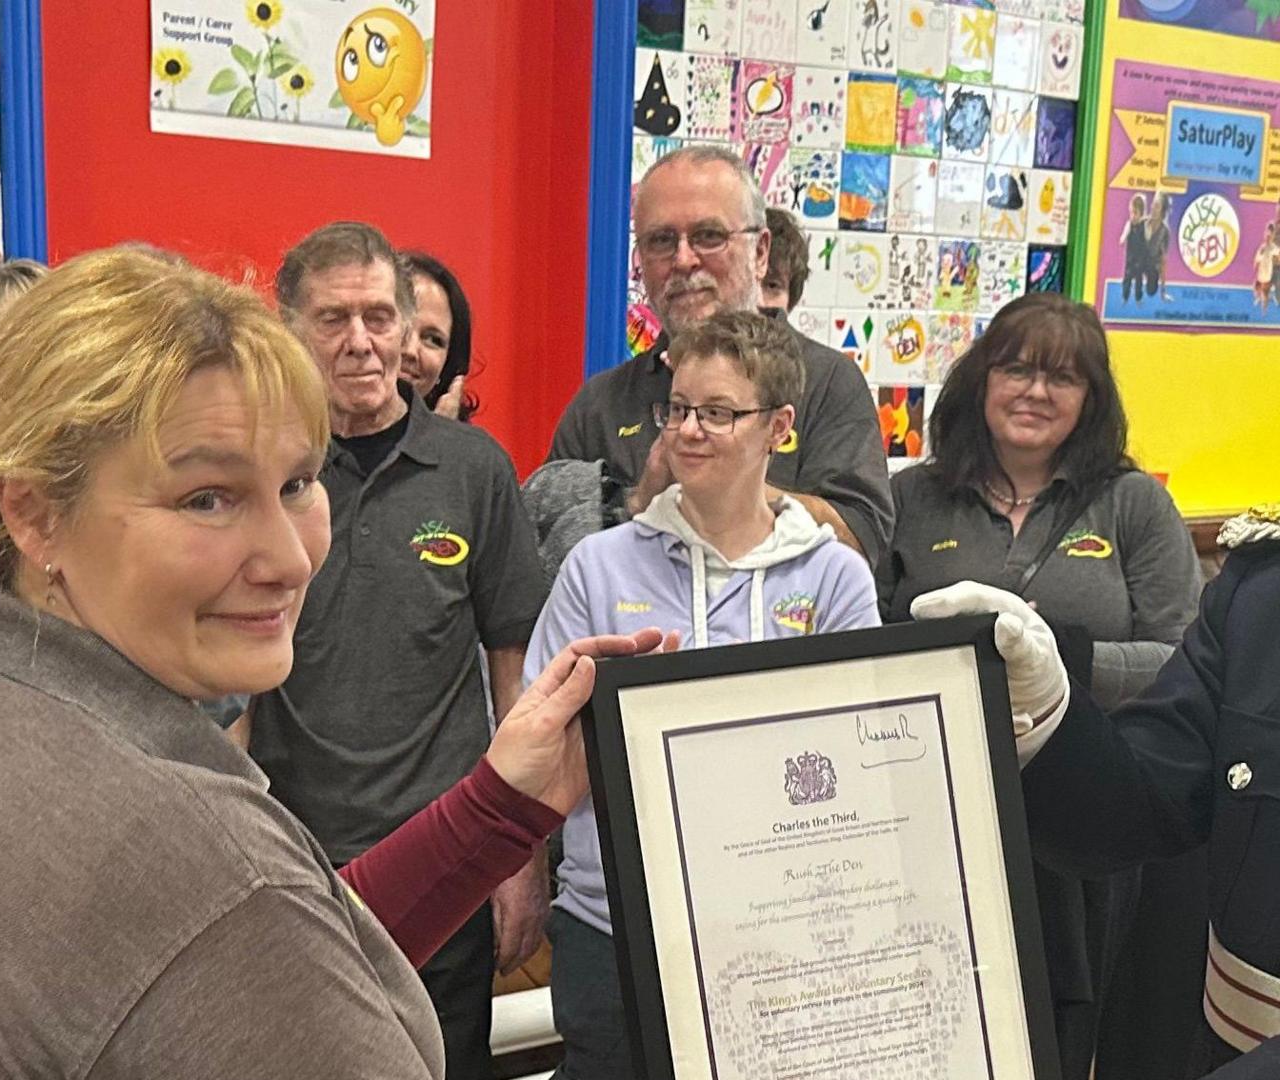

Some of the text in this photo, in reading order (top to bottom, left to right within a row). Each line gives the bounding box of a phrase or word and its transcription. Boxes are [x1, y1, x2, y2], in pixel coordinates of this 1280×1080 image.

[163, 12, 196, 26] Parent
[206, 17, 232, 31] Carer
[163, 28, 234, 47] Support Group
[1177, 119, 1256, 156] SaturPlay
[772, 811, 858, 833] Charles the Third,
[842, 858, 862, 871] Den
[749, 999, 765, 1009] The
[768, 994, 797, 1007] King's
[799, 987, 829, 999] Award
[832, 984, 846, 993] for
[849, 975, 895, 991] Voluntary
[770, 1005, 800, 1016] voluntary
[833, 995, 853, 1004] groups
[862, 990, 873, 998] the
[874, 984, 907, 996] community
